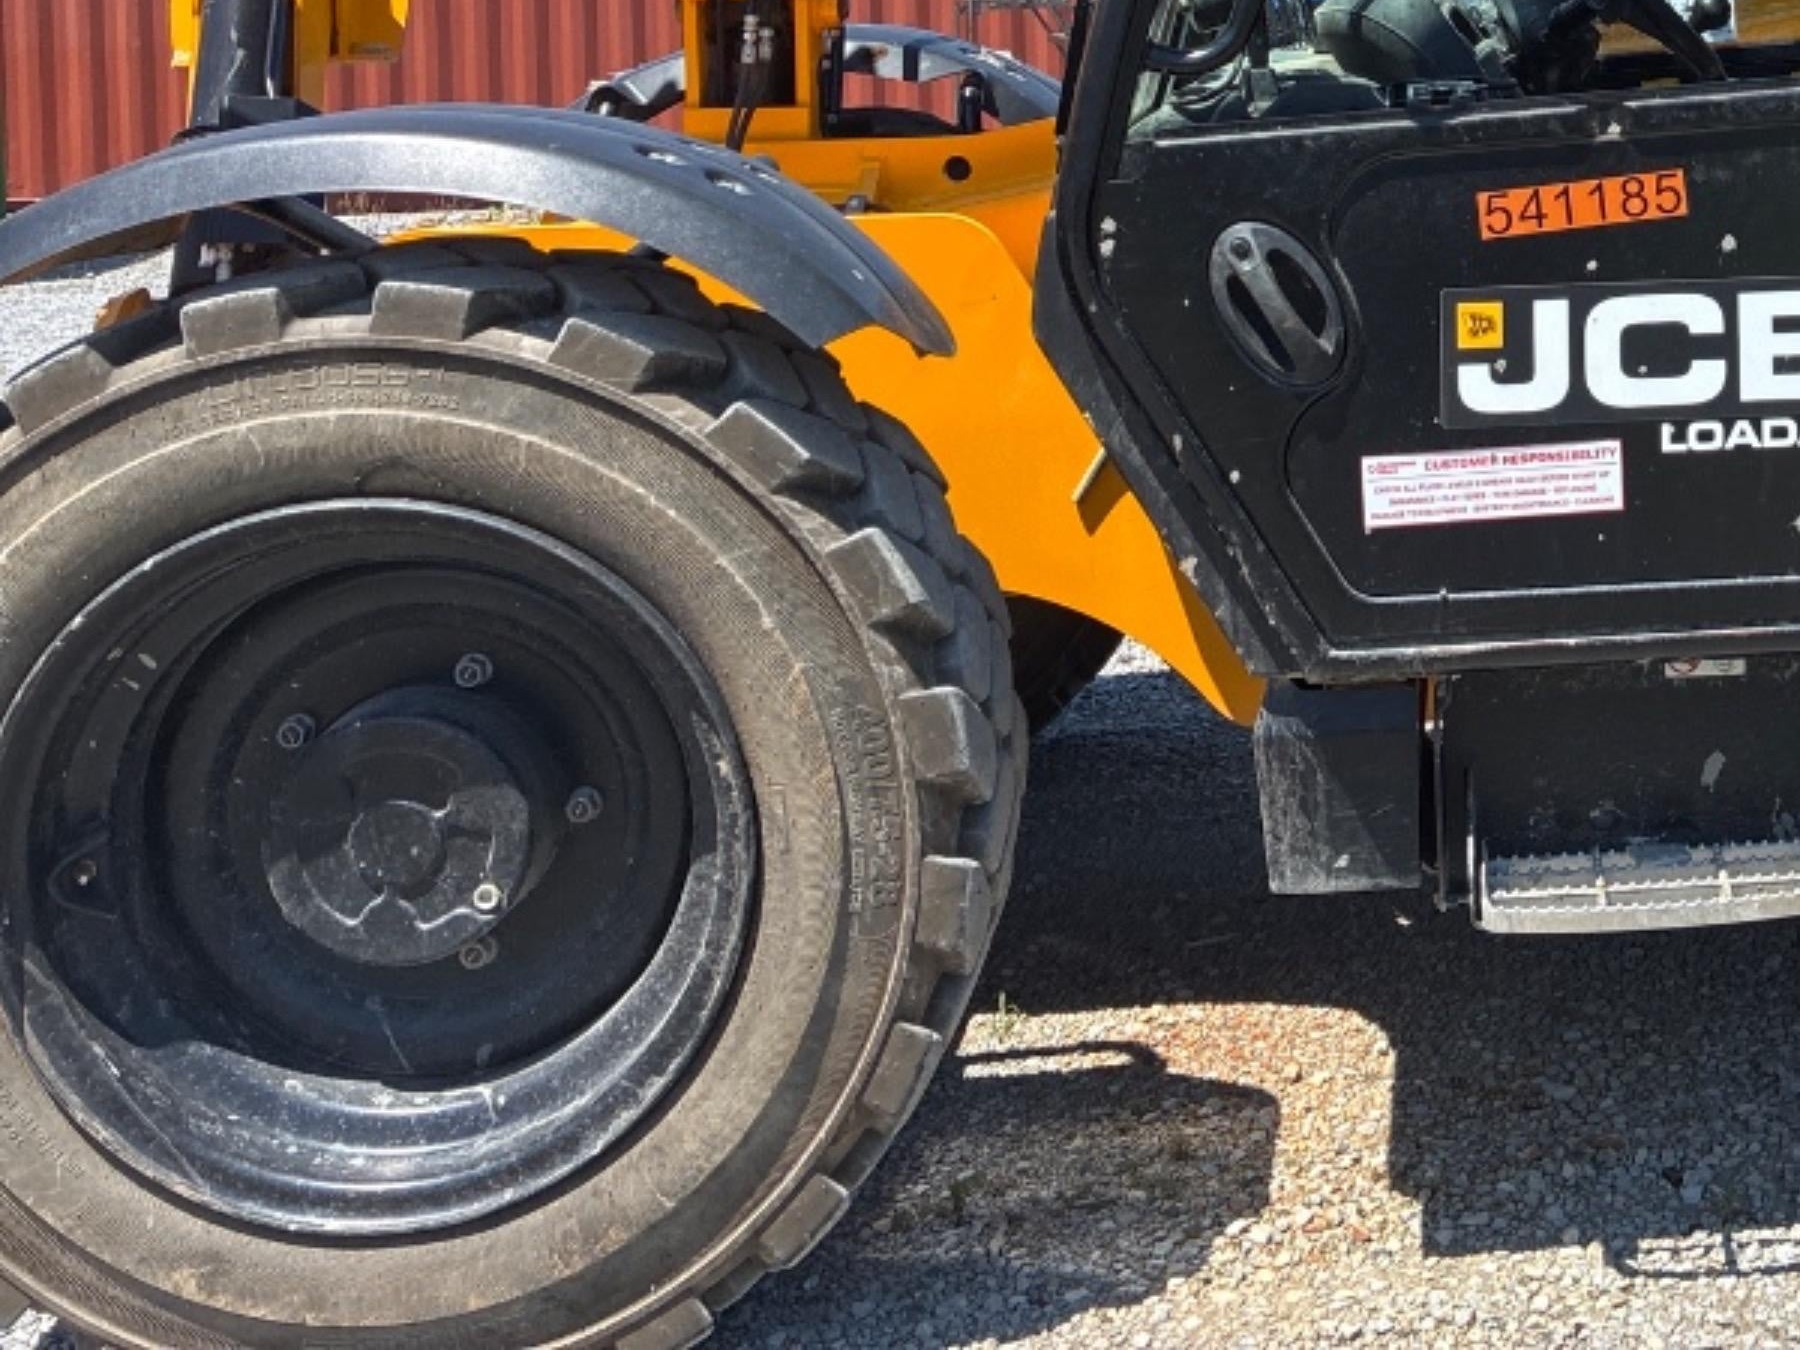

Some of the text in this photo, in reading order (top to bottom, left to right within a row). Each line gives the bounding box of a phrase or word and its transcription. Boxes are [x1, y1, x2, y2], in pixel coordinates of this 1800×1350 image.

[1484, 171, 1685, 236] 541185
[1424, 452, 1500, 472] CUSTOMER
[1501, 446, 1617, 467] RESPONSIBILITY
